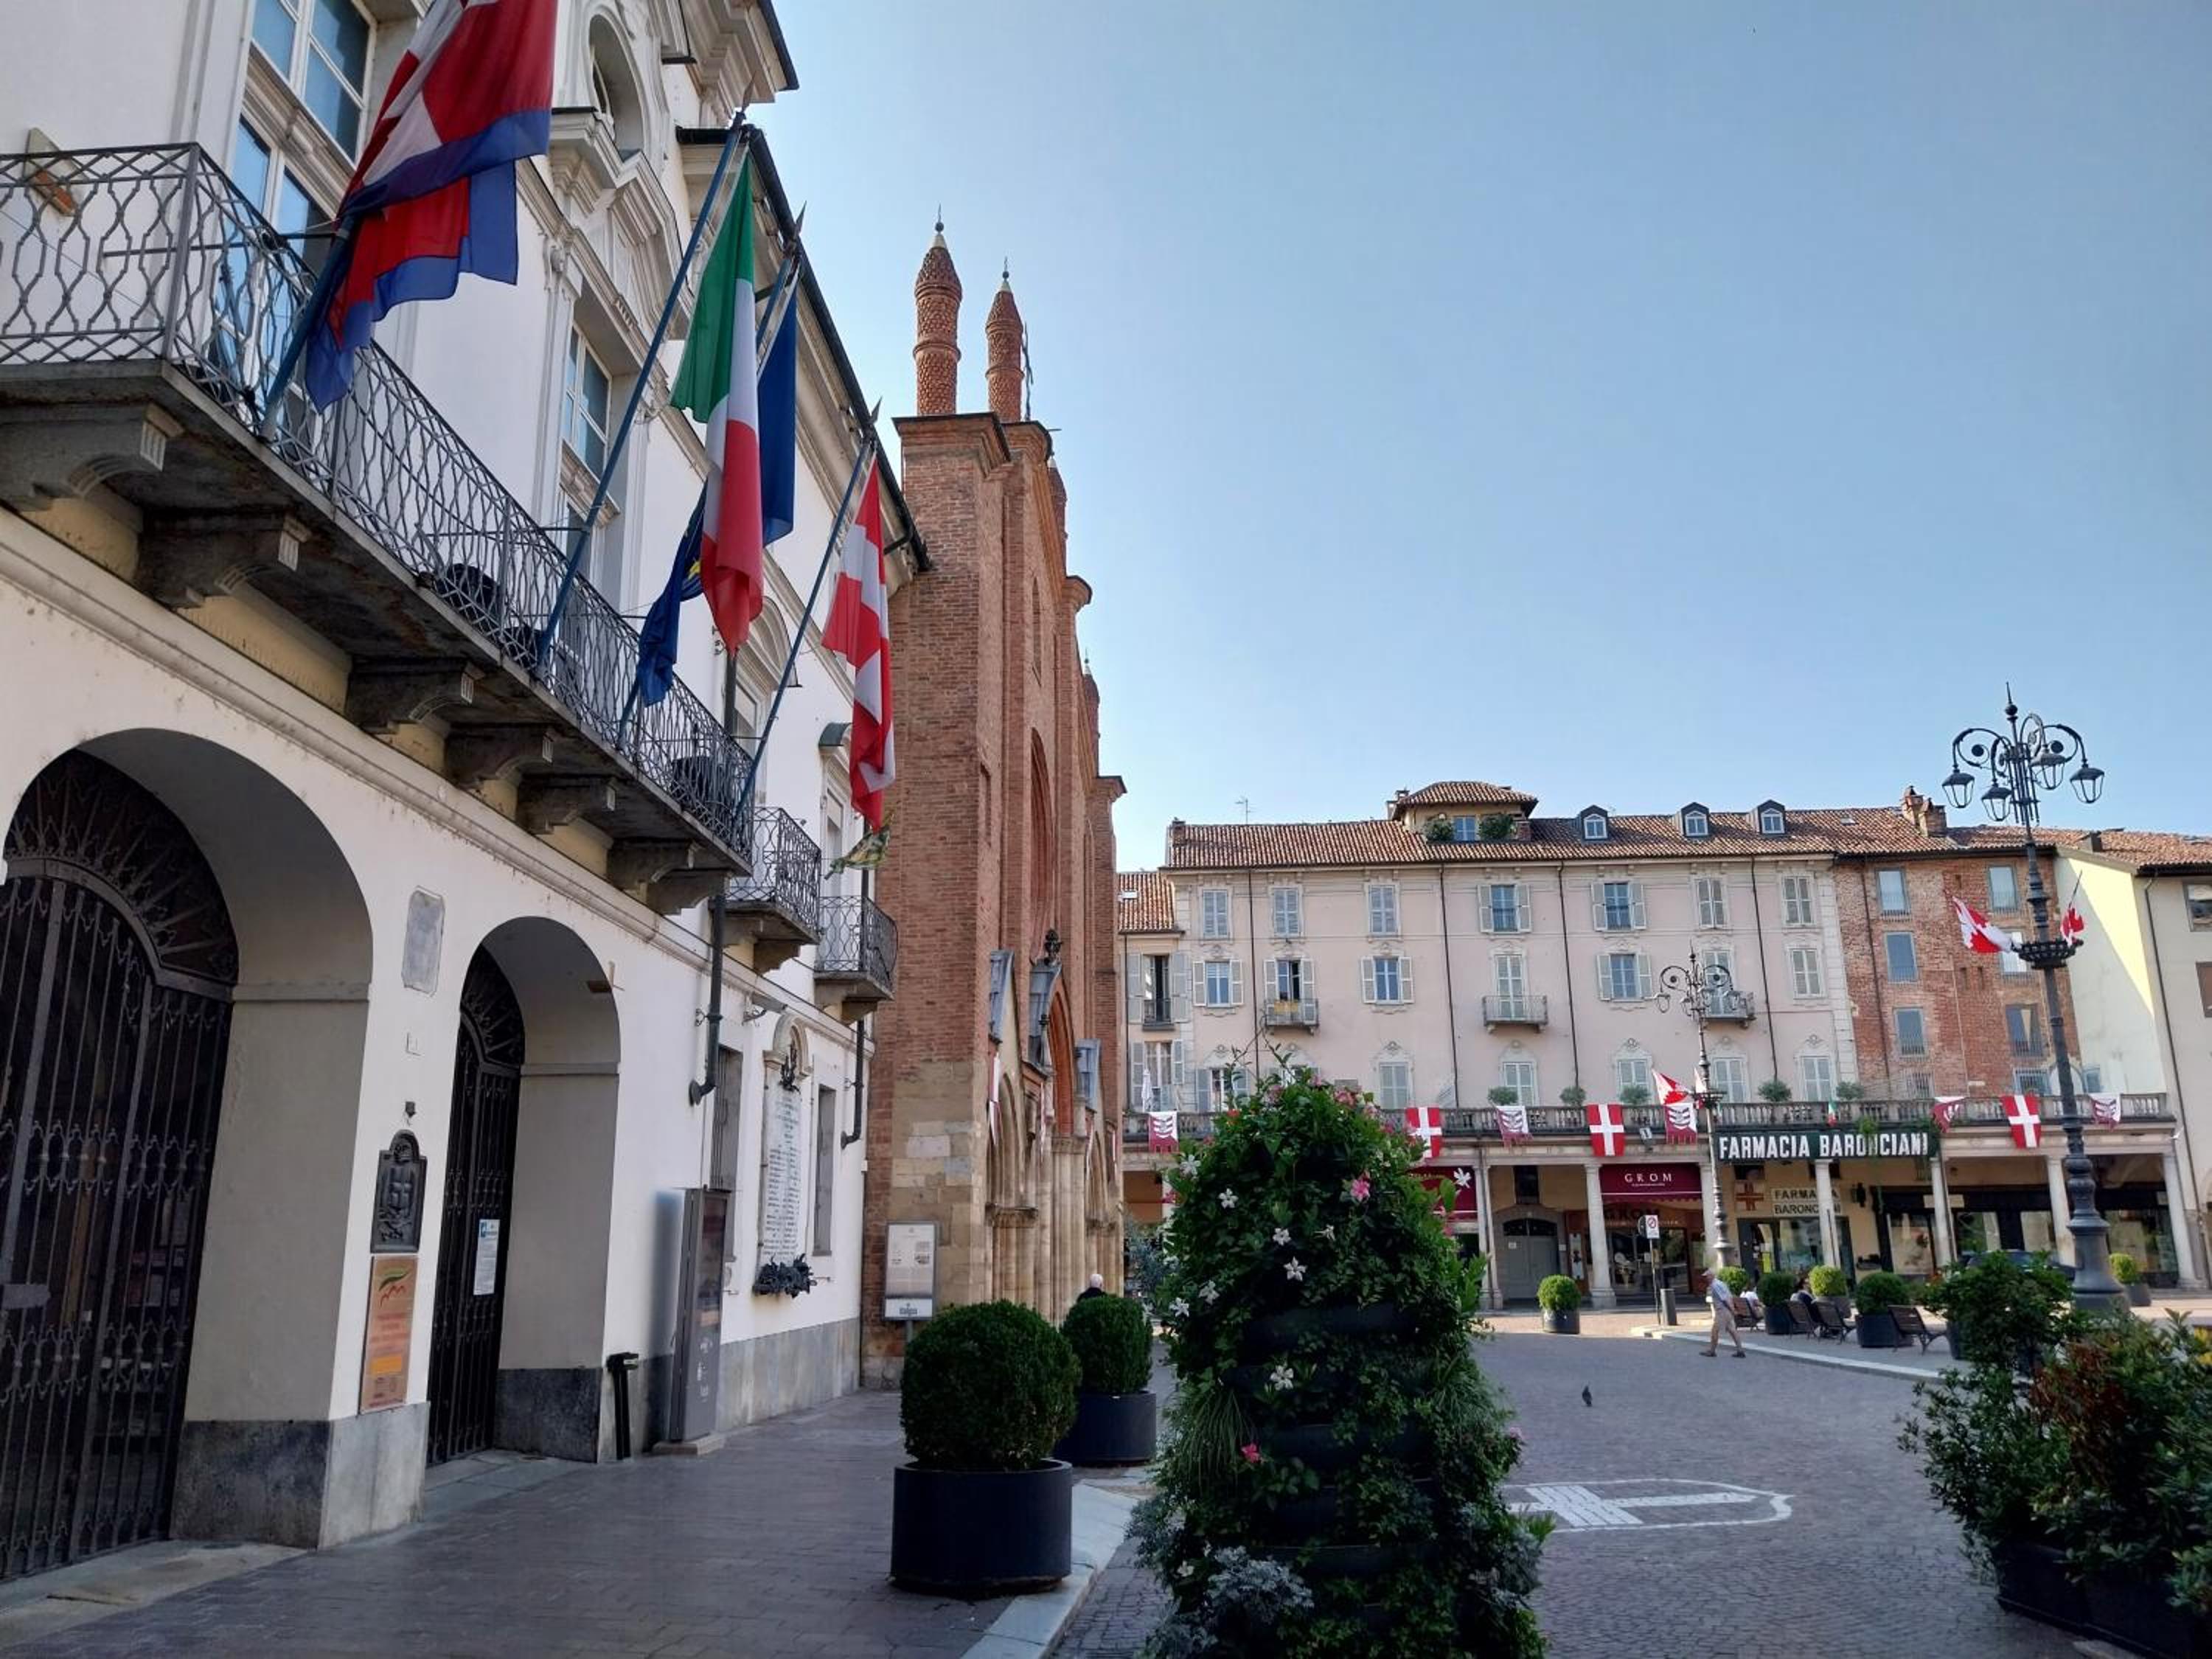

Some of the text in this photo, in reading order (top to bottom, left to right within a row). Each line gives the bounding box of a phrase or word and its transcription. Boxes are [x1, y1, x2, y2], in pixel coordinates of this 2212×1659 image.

[1719, 1133, 1928, 1159] FARMACIA BARONCIANI
[1624, 1173, 1672, 1183] GROM
[1775, 1189, 1840, 1199] FARMAA
